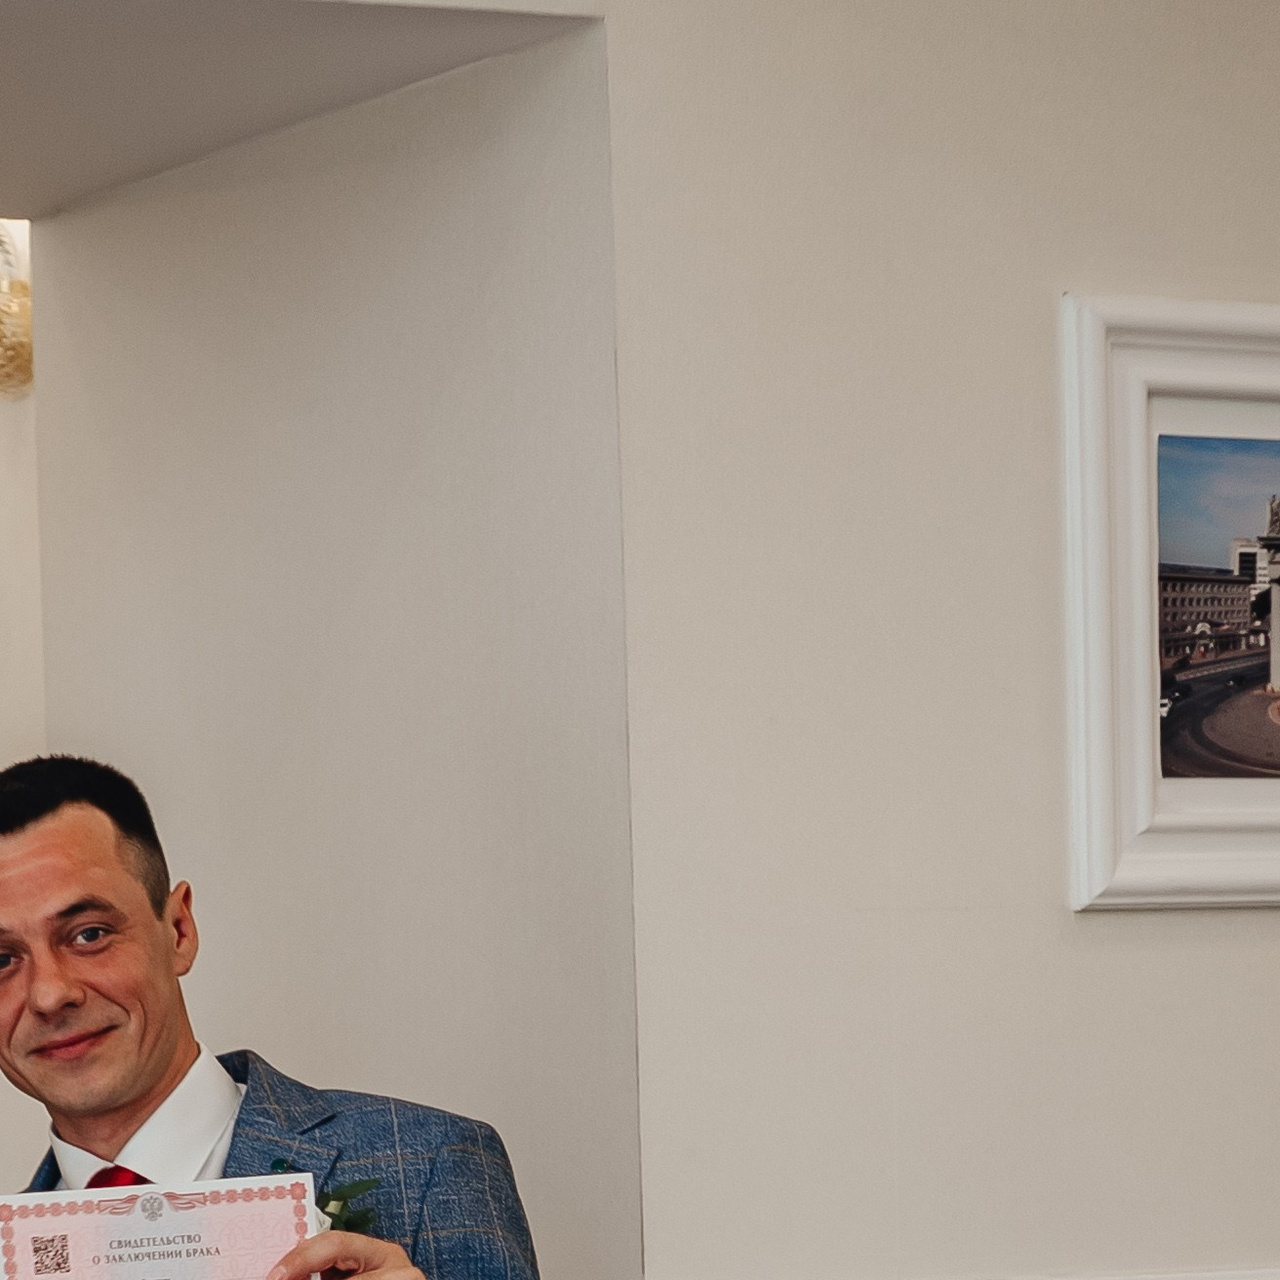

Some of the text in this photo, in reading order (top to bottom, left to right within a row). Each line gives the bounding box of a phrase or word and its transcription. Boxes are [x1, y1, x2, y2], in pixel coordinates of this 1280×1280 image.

[109, 1233, 201, 1249] СВИДЕТЕЛЬСТВО
[92, 1246, 220, 1265] О ЗАКЛЮЧЕНИИ БРАКА
